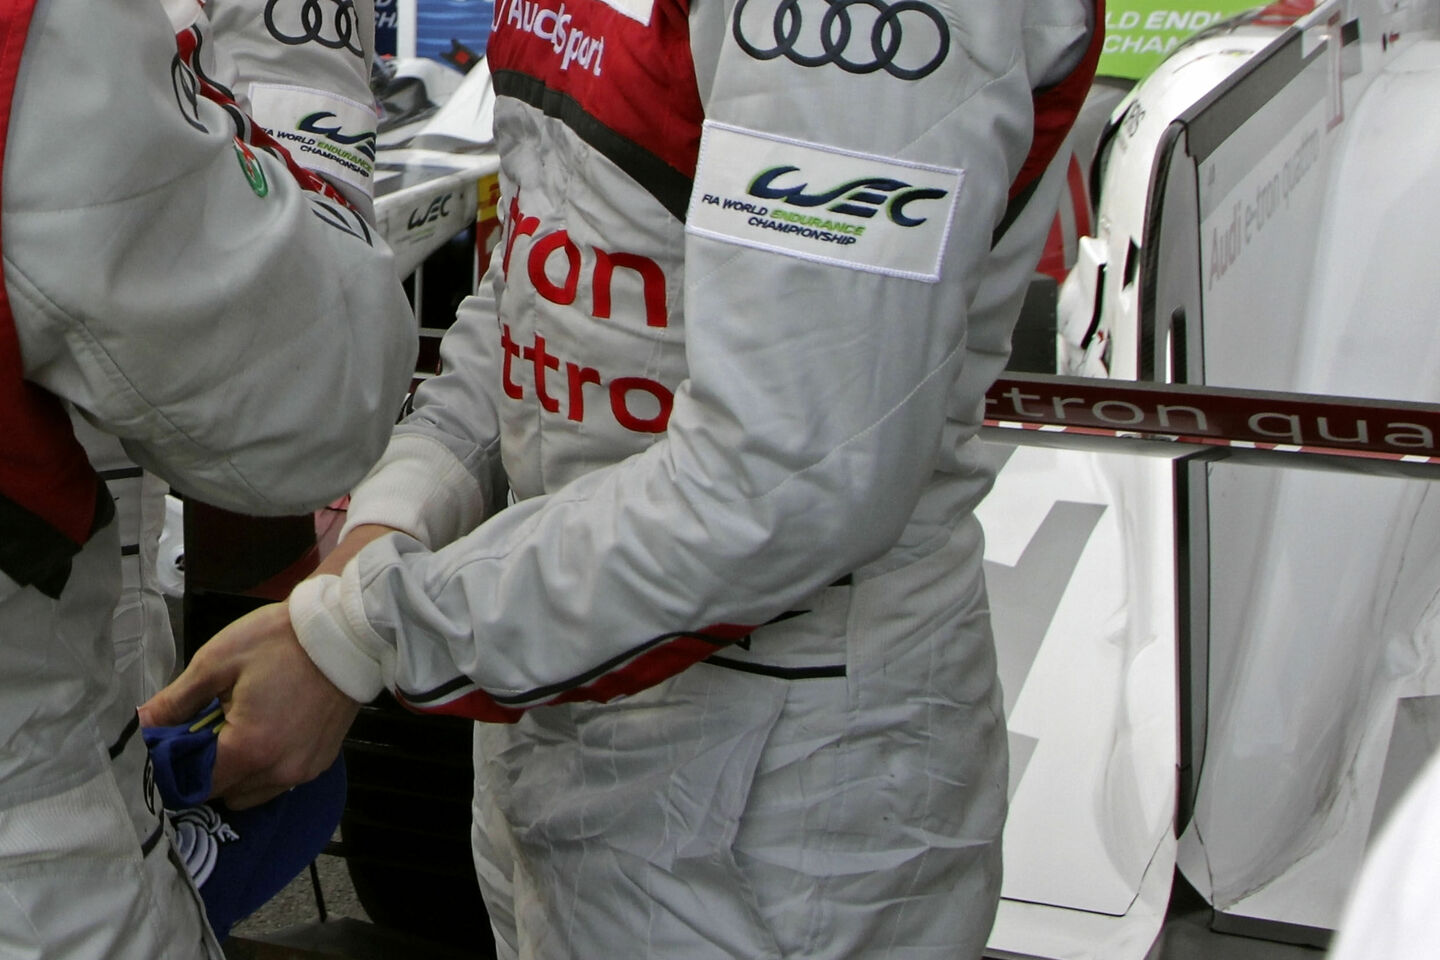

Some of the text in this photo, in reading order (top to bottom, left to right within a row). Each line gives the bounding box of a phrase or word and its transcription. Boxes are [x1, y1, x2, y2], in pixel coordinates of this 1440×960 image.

[277, 131, 316, 146] WORLD
[300, 145, 369, 178] CHAMPIONSHIP
[407, 193, 452, 230] WEC
[747, 165, 948, 227] WEC
[702, 194, 866, 236] FIA WORLD ENDURANCE
[748, 216, 856, 246] CHAMPIONSHIP
